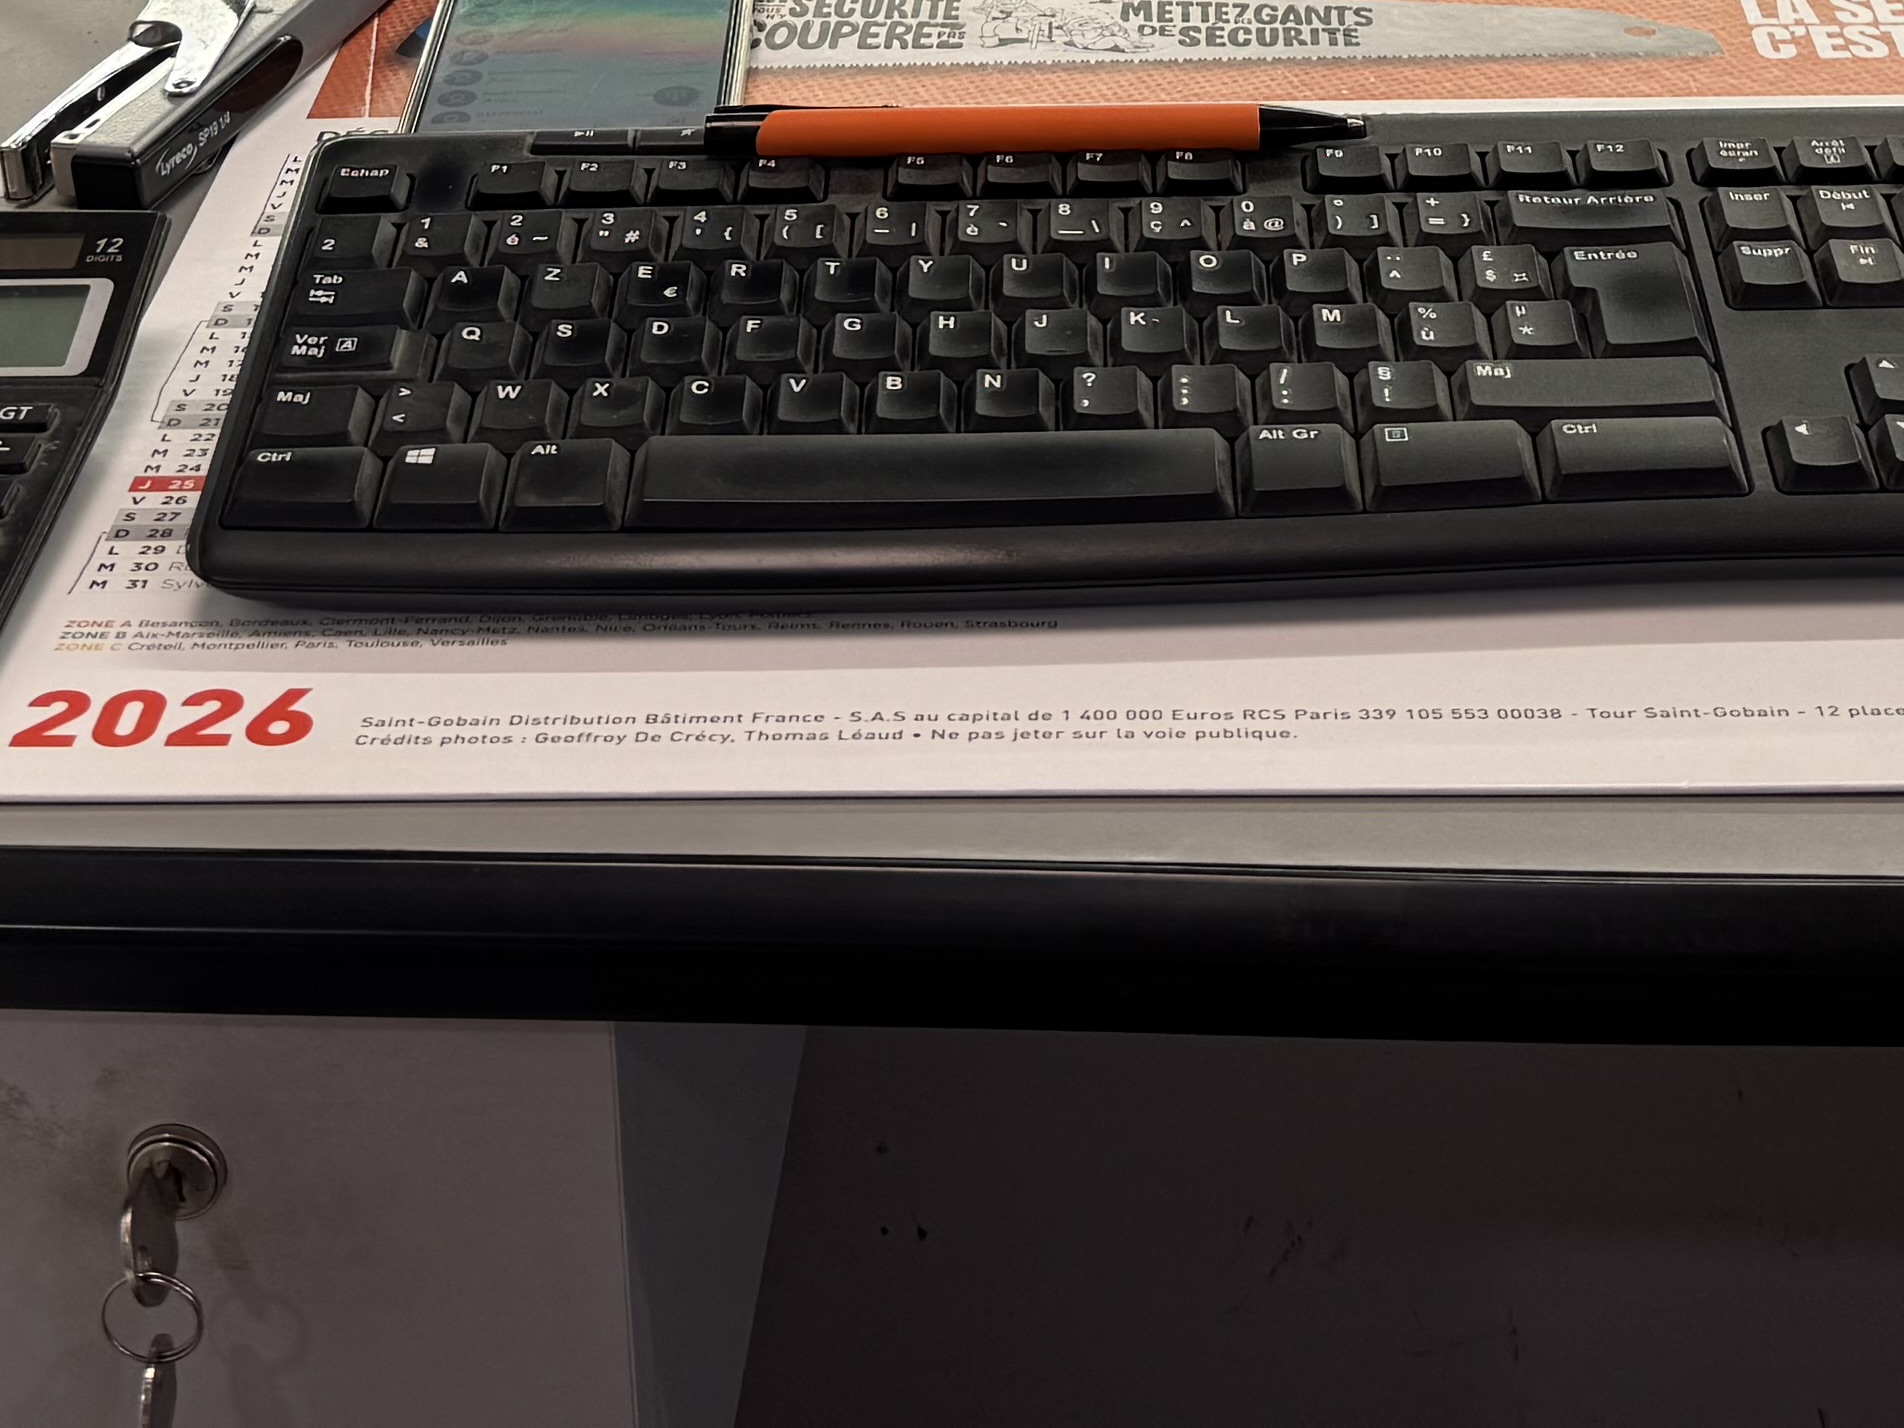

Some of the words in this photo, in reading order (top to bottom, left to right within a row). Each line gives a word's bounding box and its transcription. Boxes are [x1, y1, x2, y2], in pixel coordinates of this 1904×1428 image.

[1254, 2, 1374, 27] GANTS
[1137, 23, 1177, 38] DE
[1178, 20, 1362, 48] SÉCURITÉ
[95, 237, 125, 254] 12
[1740, 244, 1792, 260] Suppr
[1572, 247, 1638, 263] Entrée
[313, 273, 343, 286] Tab
[1258, 427, 1286, 441] Alt
[1291, 426, 1320, 442] Gr
[257, 450, 292, 464] Ctrl
[8, 687, 314, 749] 2026
[361, 715, 502, 728] Saint-Gobain
[509, 713, 638, 727] Distribution
[645, 711, 744, 724] Bâtiment
[752, 711, 825, 724] France
[849, 709, 908, 723] S.A.S
[913, 712, 940, 723] au
[946, 709, 1020, 725] capital
[1027, 709, 1054, 722] de
[1061, 708, 1071, 722] 1
[1079, 708, 1118, 721] 400
[1125, 708, 1164, 721] 000
[1171, 708, 1234, 721] Euros
[1242, 708, 1286, 721] RCS
[1294, 708, 1352, 721] Paris
[1358, 707, 1397, 720] 339
[1406, 707, 1444, 720] 105
[1450, 707, 1489, 720] 553
[1496, 706, 1562, 720] 00038
[1586, 706, 1638, 719] Tour
[1644, 705, 1790, 719] Saint-Gobain
[1814, 705, 1840, 717] 12
